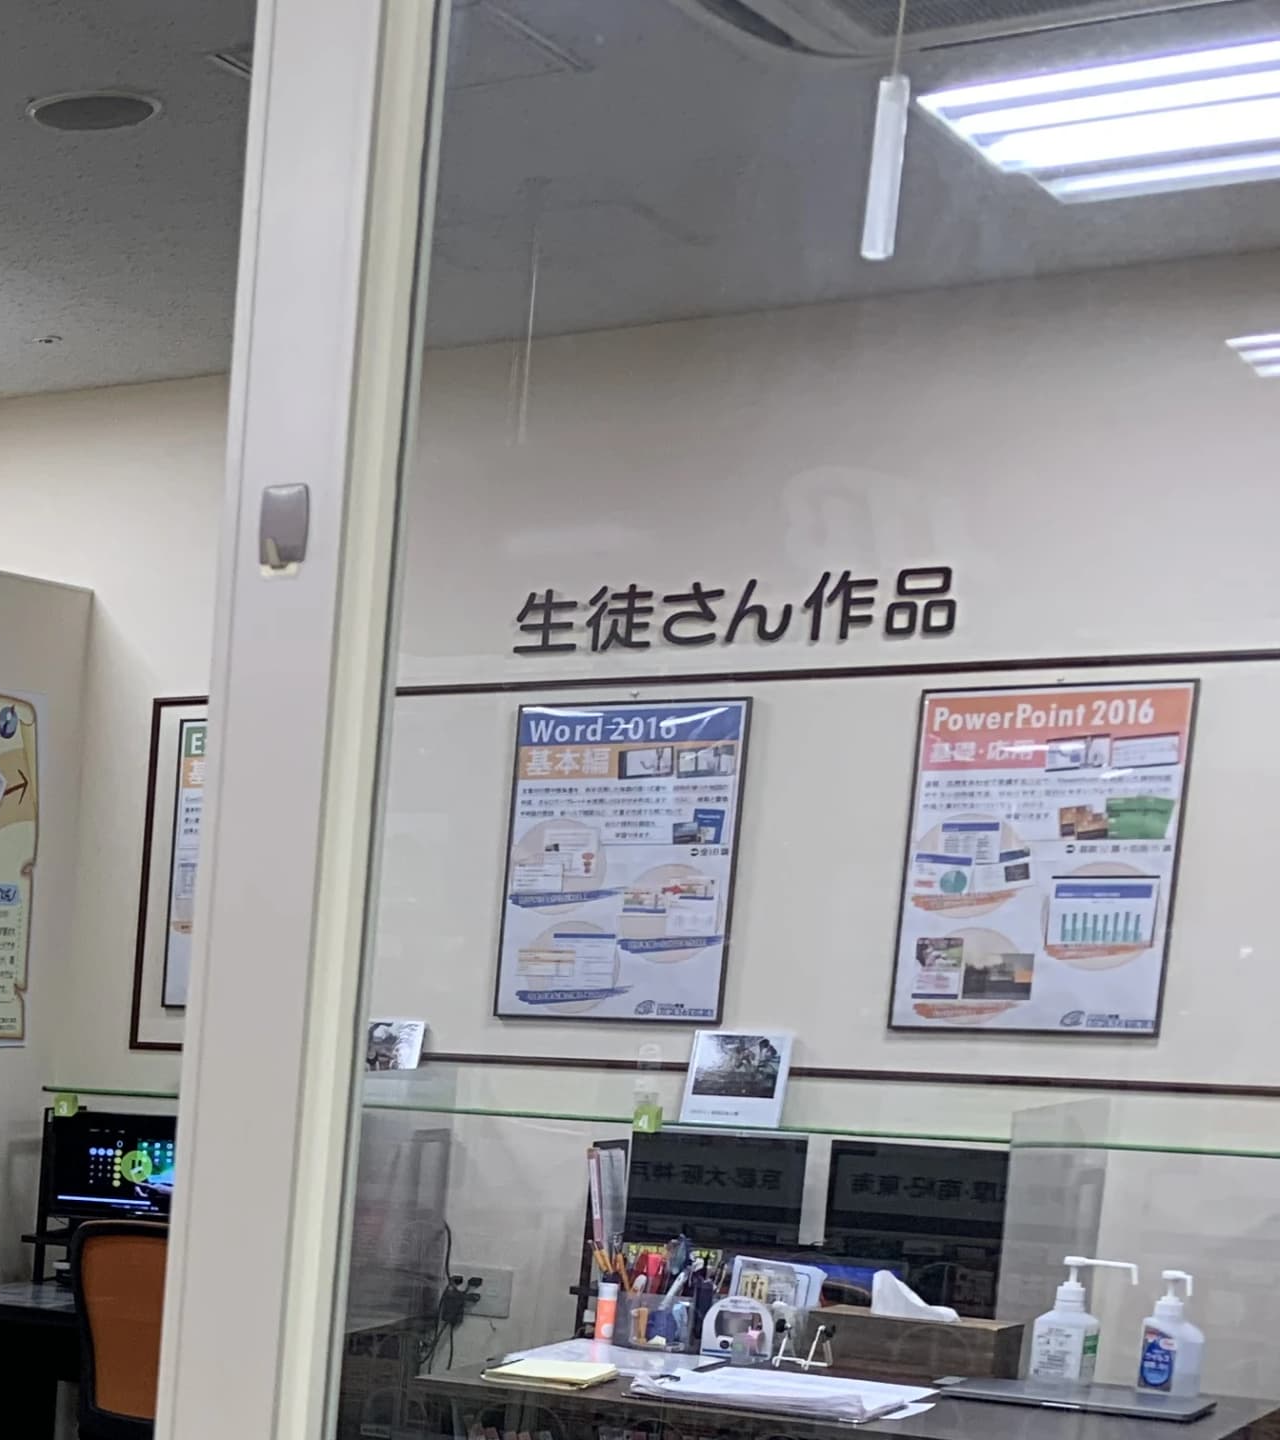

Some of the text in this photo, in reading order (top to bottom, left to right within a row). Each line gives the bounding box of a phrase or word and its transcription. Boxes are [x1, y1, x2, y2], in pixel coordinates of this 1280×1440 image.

[512, 566, 957, 655] 生徒さん作品
[528, 716, 677, 743] Word 2016
[933, 698, 1155, 733] PowerPoint 2016
